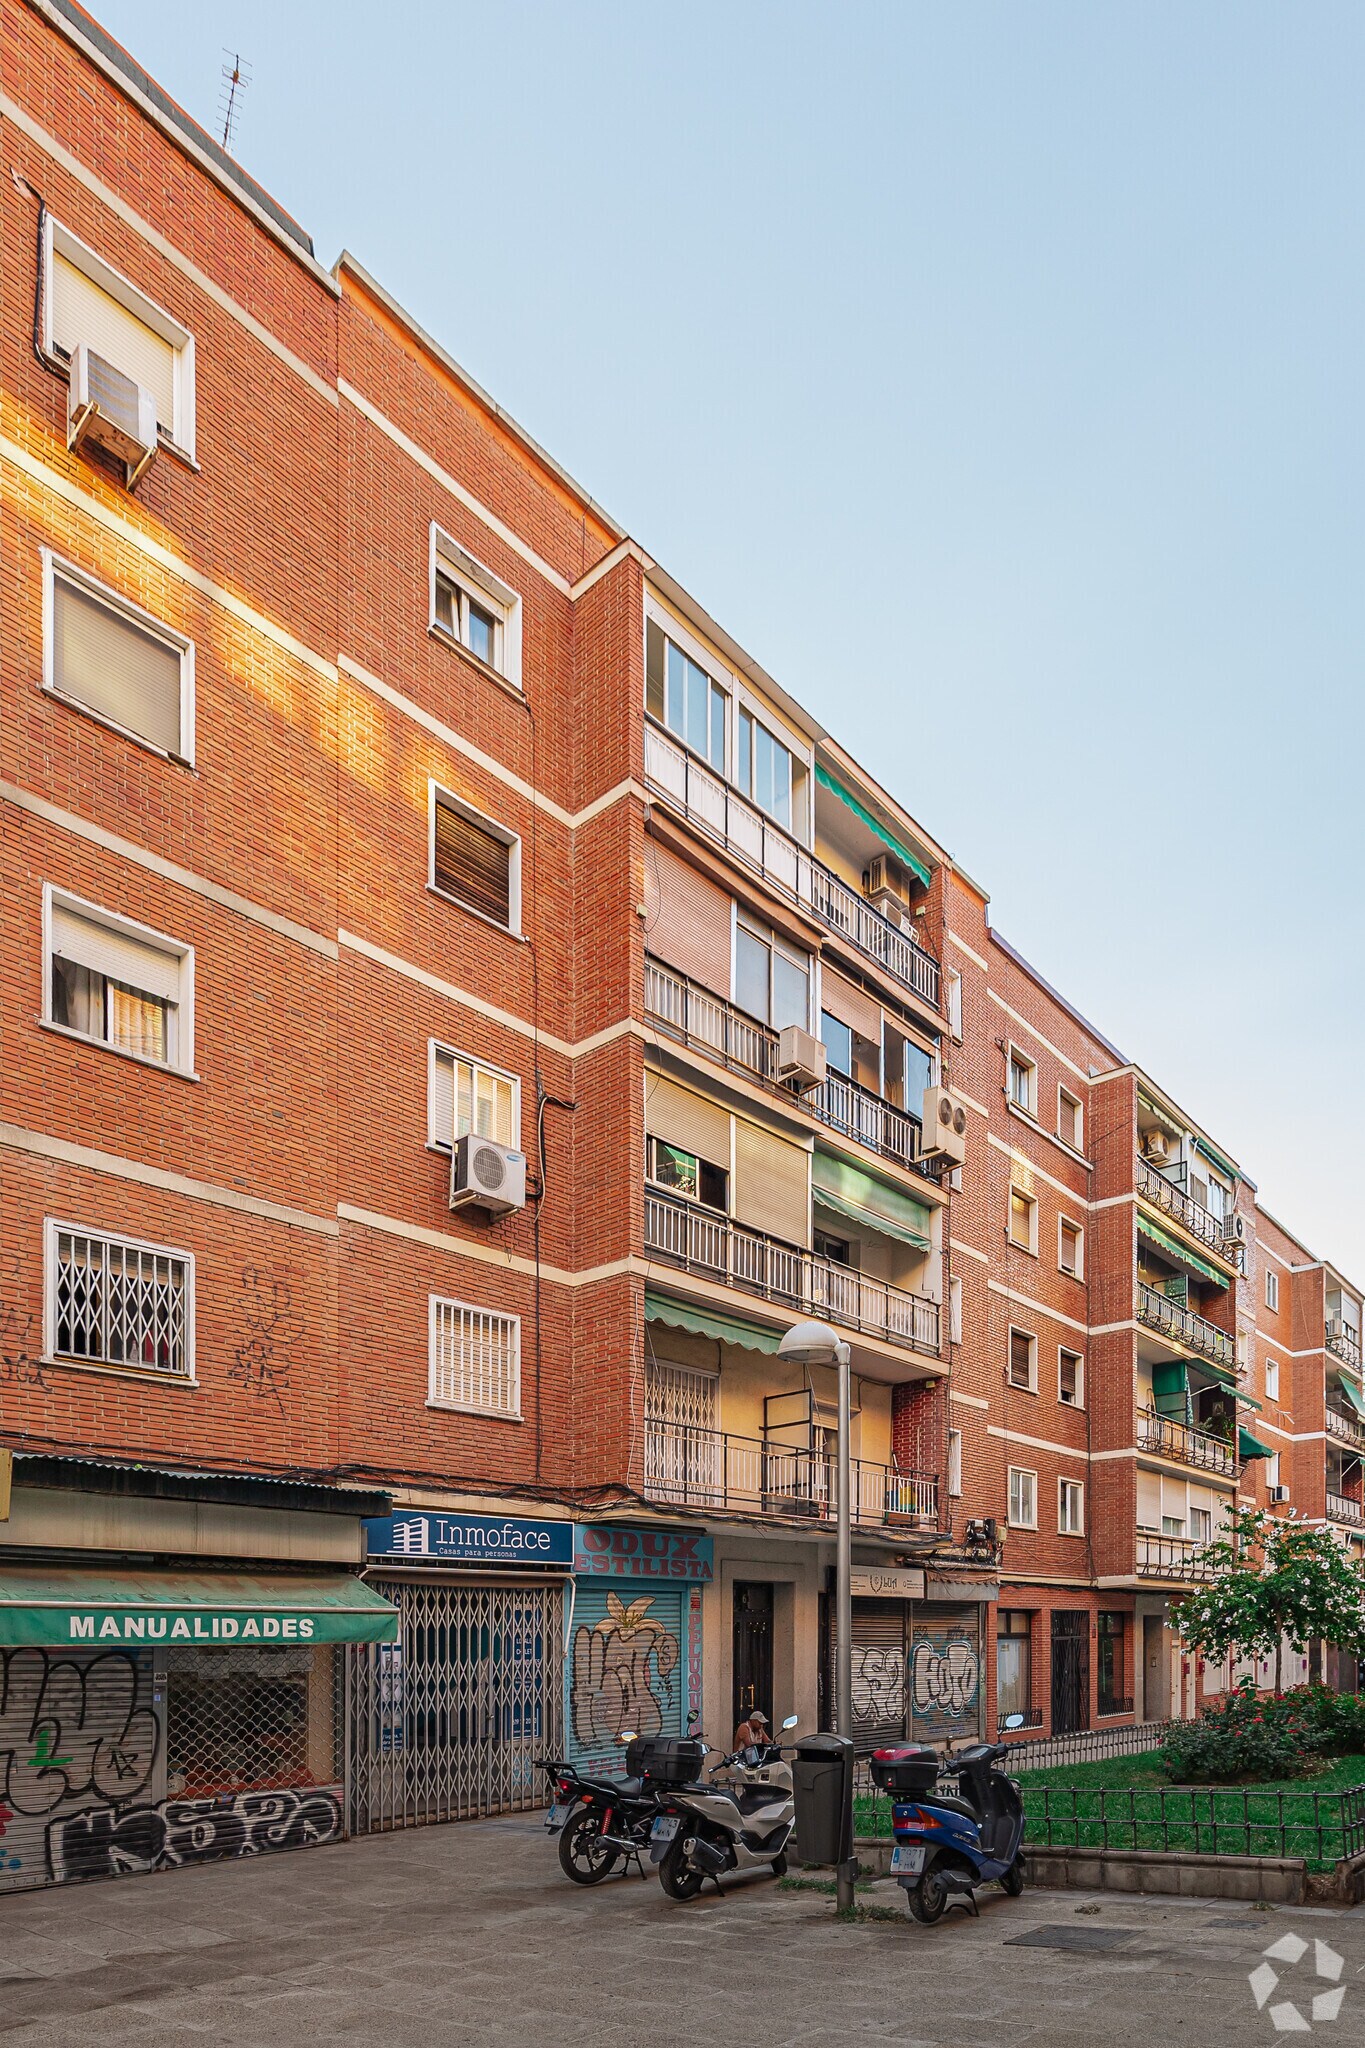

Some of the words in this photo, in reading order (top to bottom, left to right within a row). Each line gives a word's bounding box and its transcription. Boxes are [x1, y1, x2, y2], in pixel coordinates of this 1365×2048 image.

[435, 1519, 551, 1550] Inmoface
[583, 1529, 700, 1559] ODUX
[439, 1547, 461, 1556] Casas
[464, 1549, 482, 1557] para
[485, 1550, 517, 1559] personas
[572, 1553, 713, 1578] ESTILISTA
[69, 1616, 314, 1638] MANUALIDADES
